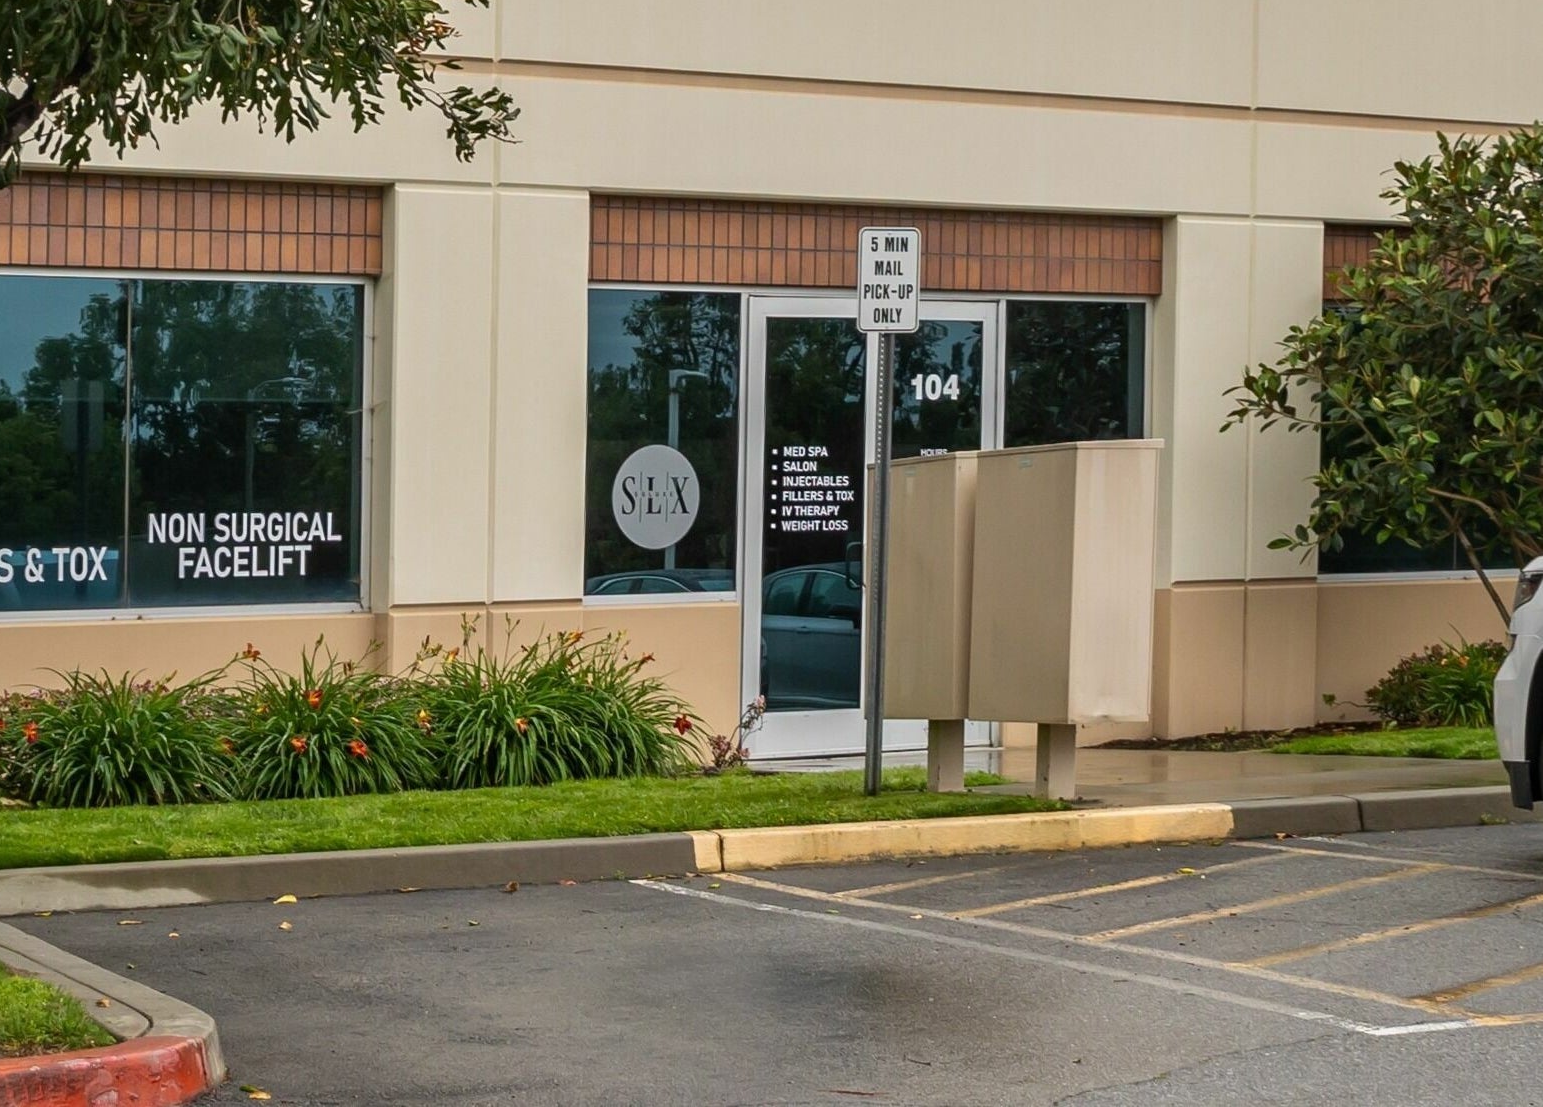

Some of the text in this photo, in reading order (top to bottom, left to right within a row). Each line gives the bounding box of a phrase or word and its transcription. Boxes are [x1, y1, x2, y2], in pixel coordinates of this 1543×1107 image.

[870, 236, 909, 253] 5 MIN
[874, 260, 904, 276] MAIL
[863, 283, 914, 300] PICK-UP
[873, 307, 902, 324] ONLY
[910, 373, 960, 401] 104
[783, 446, 829, 457] MED SPA
[782, 460, 818, 473] SALON
[782, 475, 850, 487] INJECTABLES
[782, 490, 855, 502] FILLERS & TOX
[782, 504, 840, 517] IV THERAPY
[147, 511, 343, 544] NON SURGICAL
[781, 519, 849, 532] WEIGHT LOSS
[24, 547, 45, 583] &
[51, 545, 109, 582] TOX
[177, 543, 313, 579] FACELIFT
